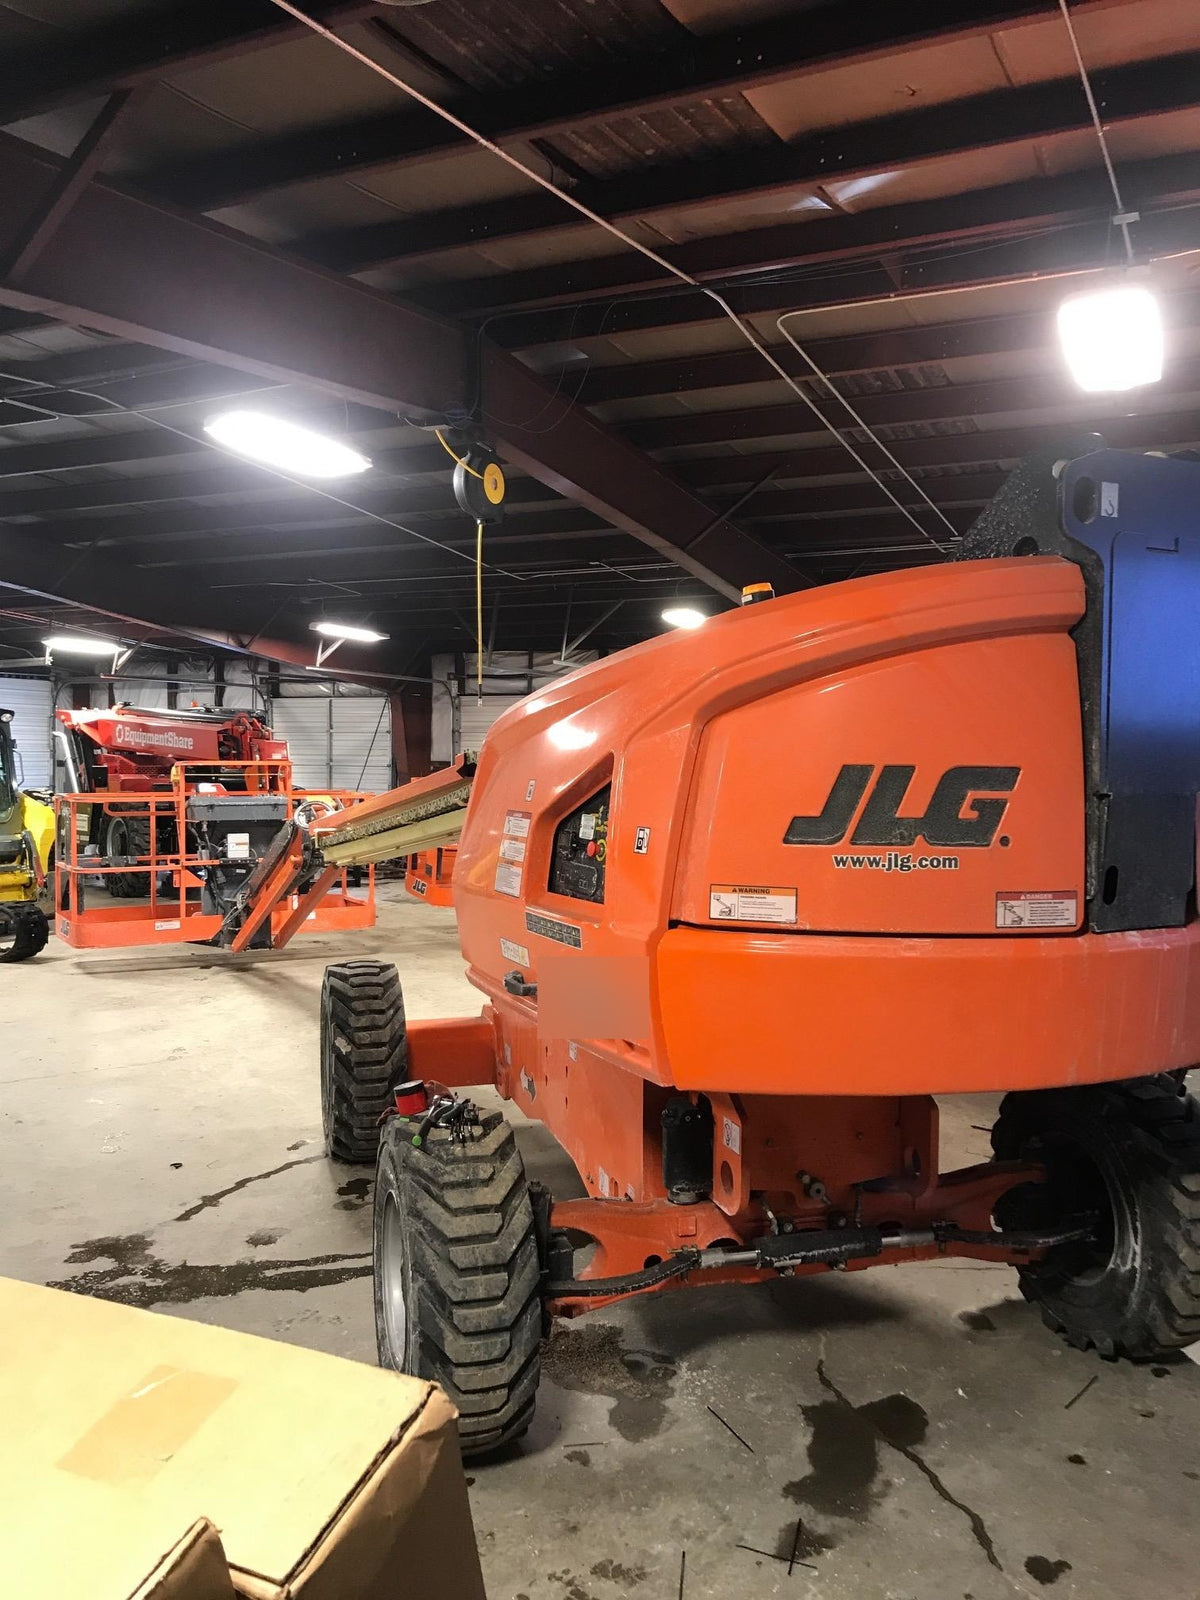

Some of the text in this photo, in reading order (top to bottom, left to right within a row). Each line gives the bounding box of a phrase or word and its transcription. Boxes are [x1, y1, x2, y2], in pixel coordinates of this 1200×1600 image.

[124, 726, 194, 750] EquipmentShare
[833, 853, 959, 871] www.jlg.com
[412, 879, 427, 895] JLG
[738, 887, 771, 895] WARNING
